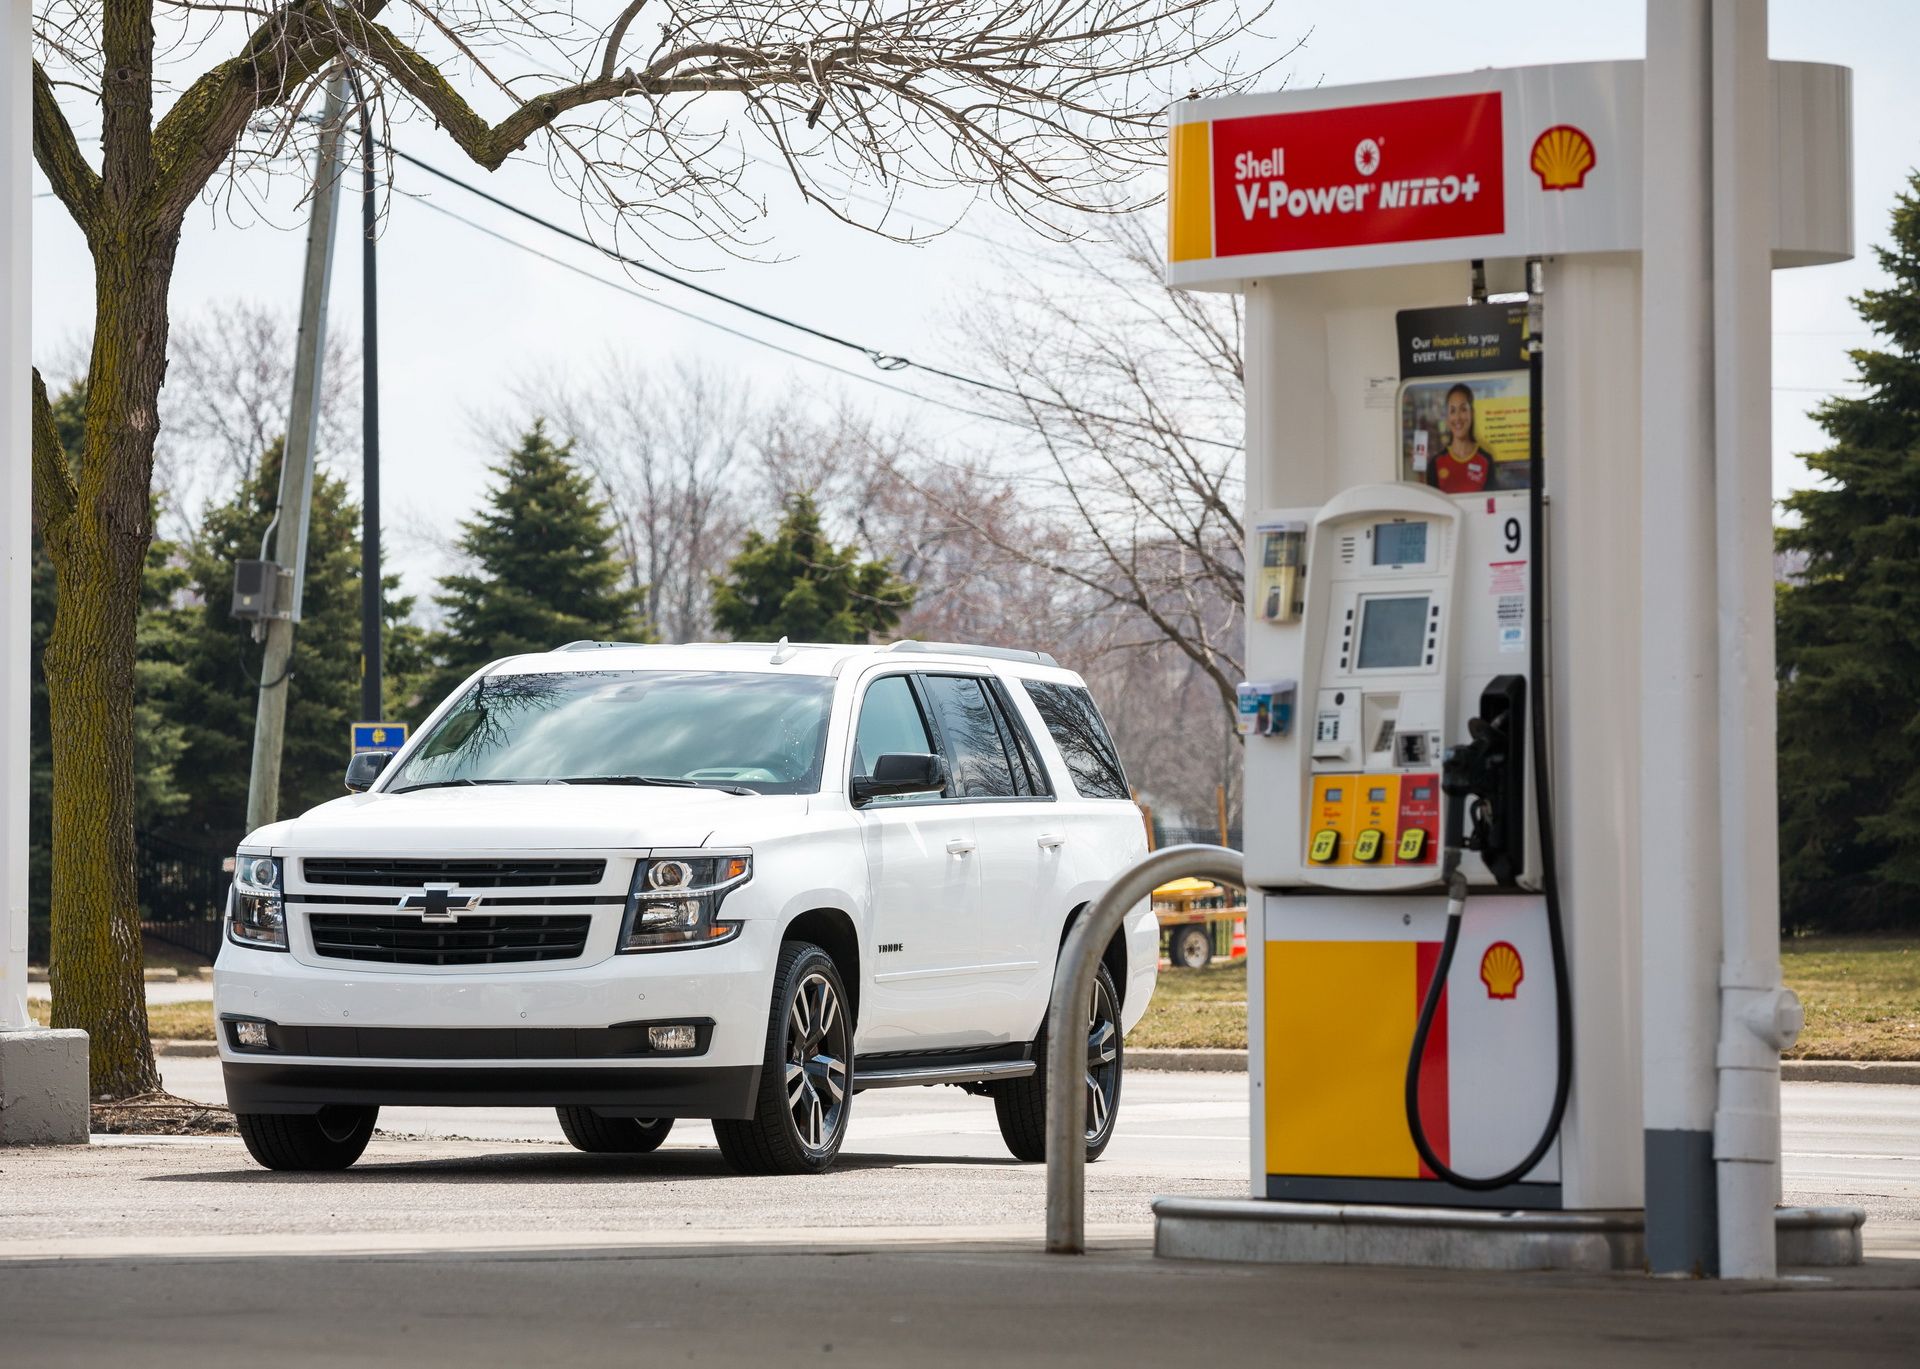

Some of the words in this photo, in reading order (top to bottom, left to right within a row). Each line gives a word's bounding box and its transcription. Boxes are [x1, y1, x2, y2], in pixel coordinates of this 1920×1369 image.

[1235, 147, 1284, 180] Shell
[1235, 181, 1370, 220] V-Power
[1411, 337, 1431, 350] Our
[1432, 333, 1467, 348] thanks
[1468, 334, 1479, 345] to
[1481, 333, 1499, 348] you
[1413, 351, 1437, 363] EVERY
[1455, 348, 1480, 360] EVERY
[1504, 517, 1521, 553] 9
[1315, 842, 1330, 854] 87
[1403, 840, 1417, 853] 93
[878, 943, 904, 953] TAHOE
